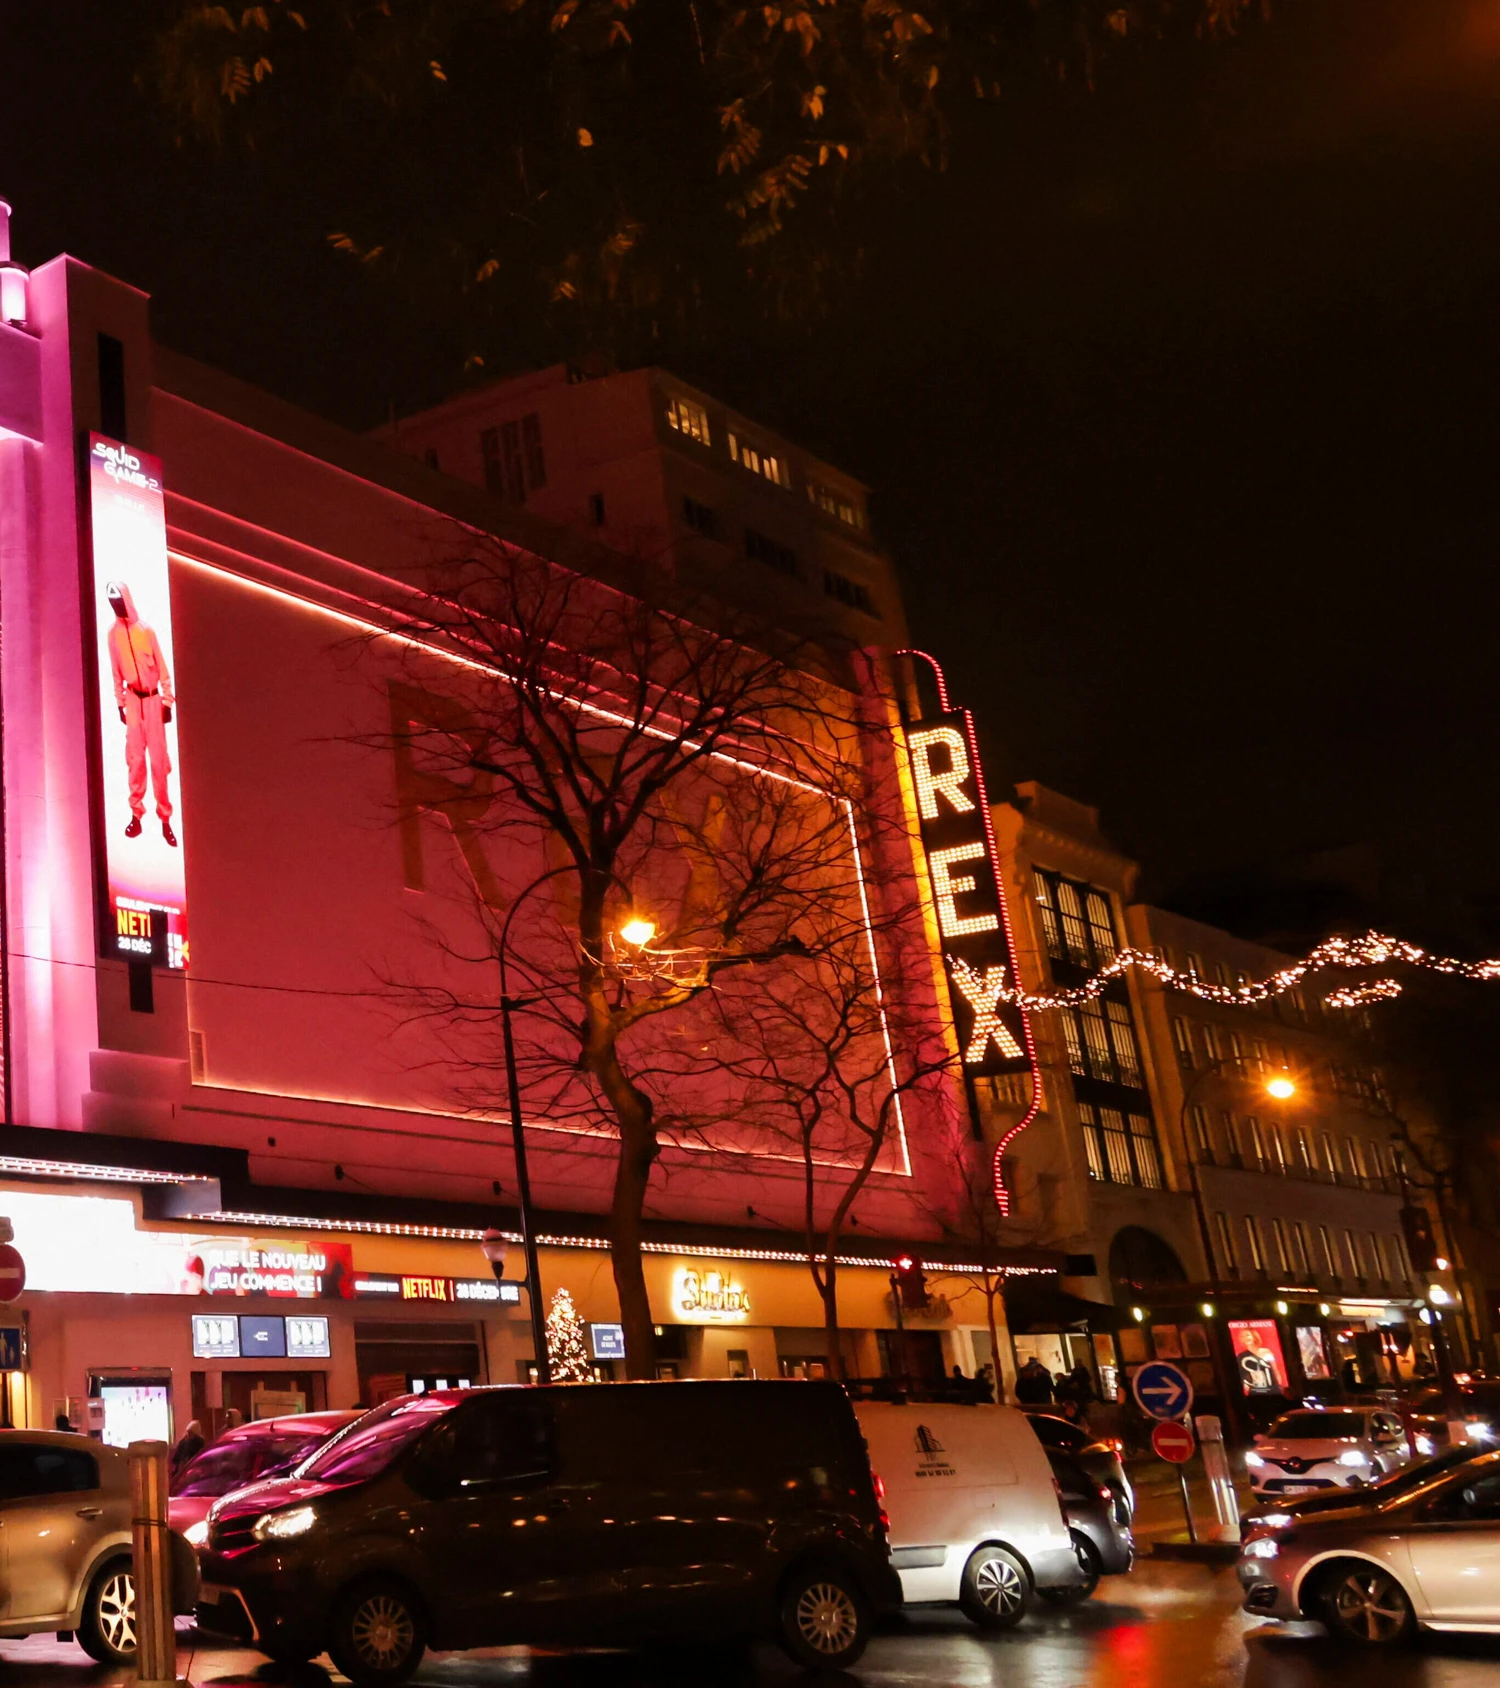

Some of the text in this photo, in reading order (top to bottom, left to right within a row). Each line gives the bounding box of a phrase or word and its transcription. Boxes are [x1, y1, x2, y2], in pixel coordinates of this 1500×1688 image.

[92, 442, 140, 471] SQUID
[908, 727, 1024, 1063] REX
[241, 1251, 260, 1268] LE
[262, 1253, 327, 1272] NOUVEAU
[210, 1272, 238, 1290] JEU
[240, 1274, 316, 1292] COMMENCE
[402, 1277, 447, 1301] NETFLIX
